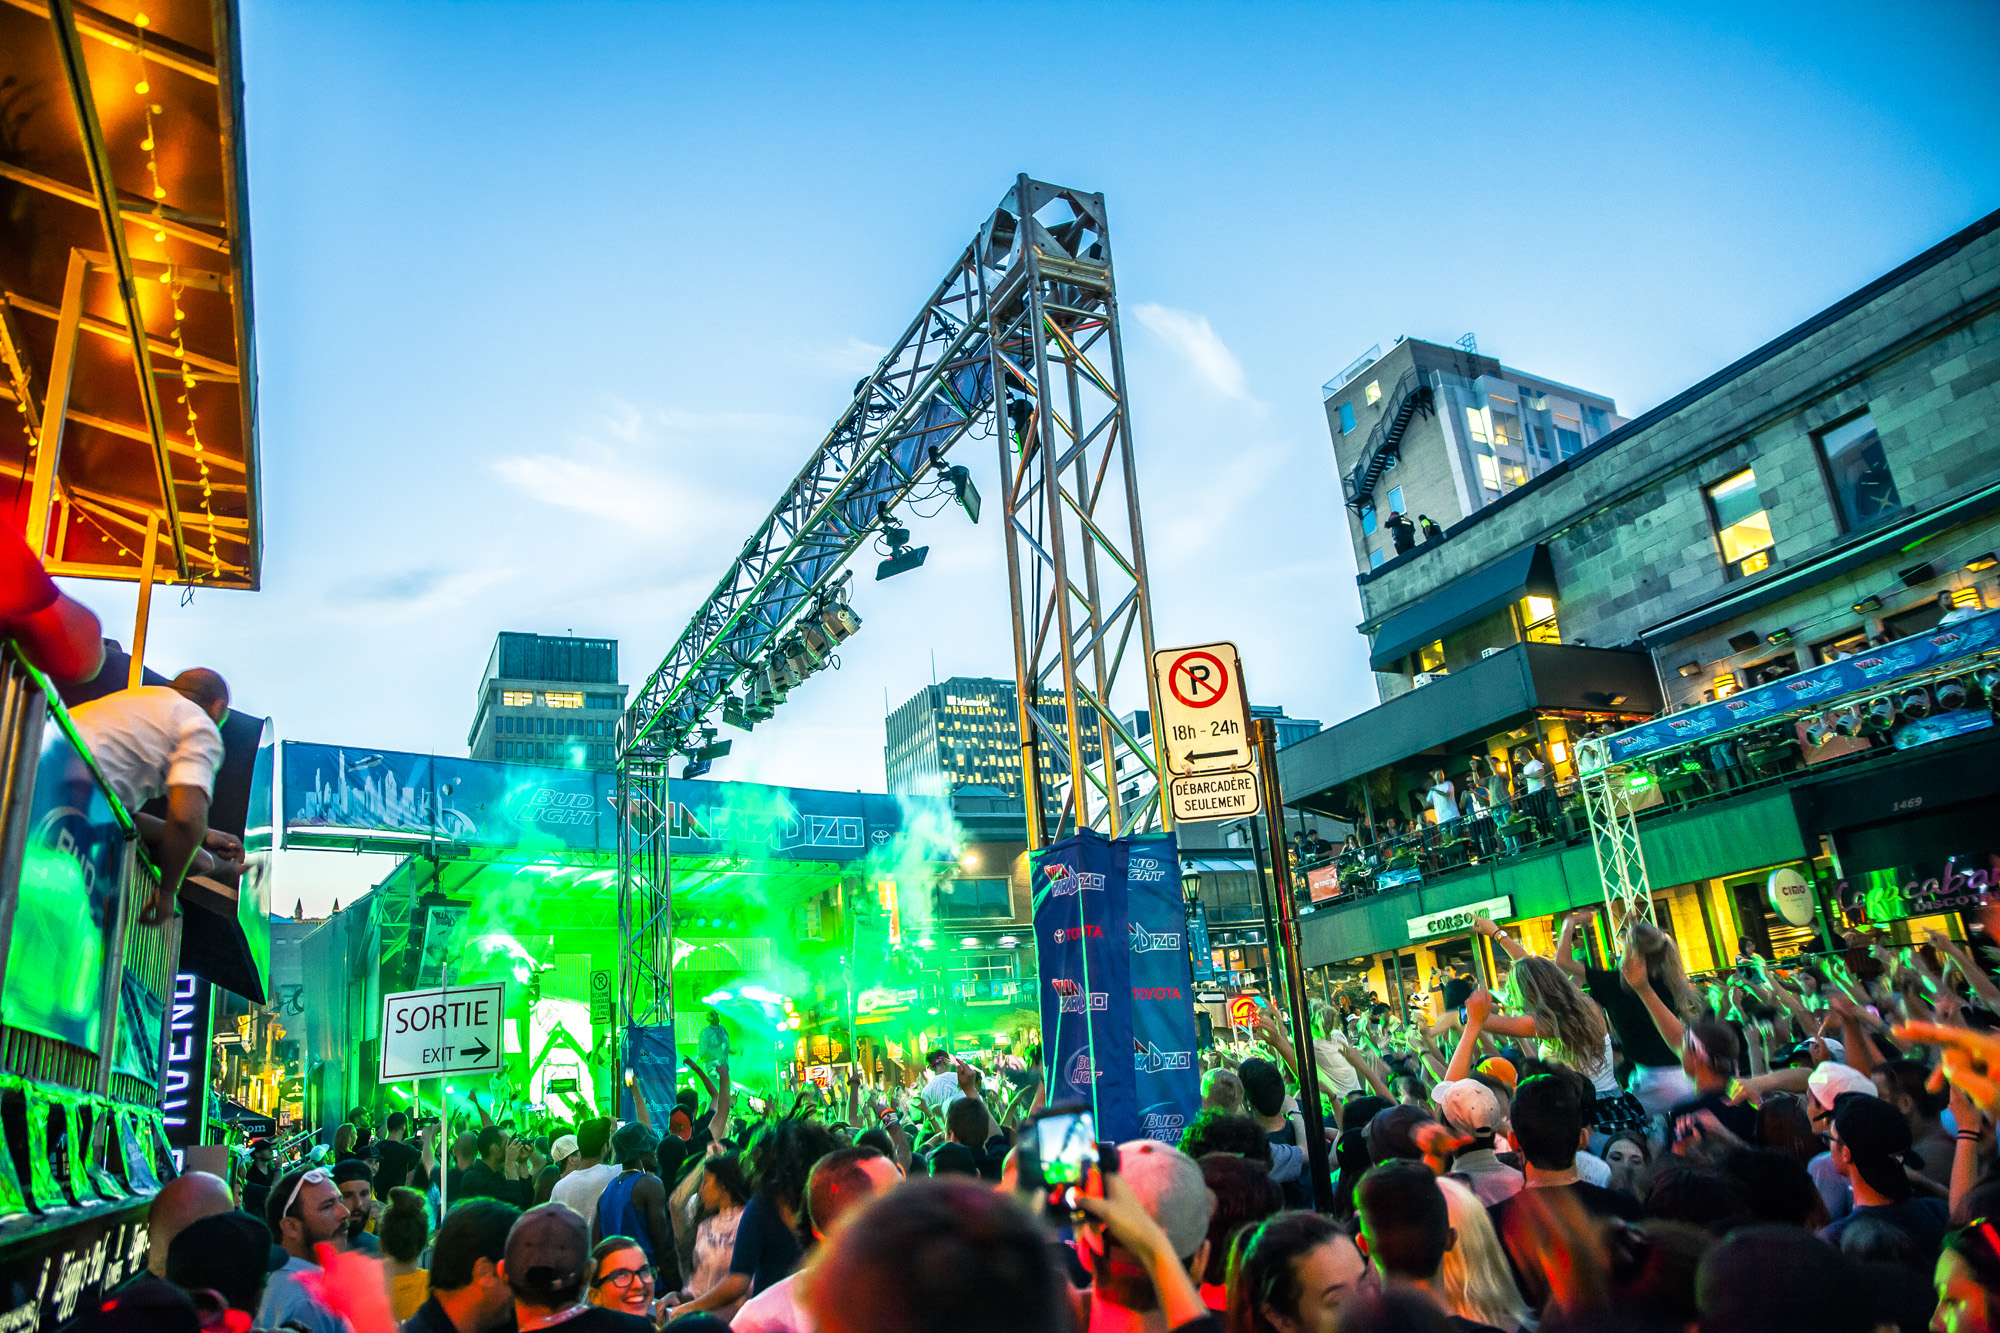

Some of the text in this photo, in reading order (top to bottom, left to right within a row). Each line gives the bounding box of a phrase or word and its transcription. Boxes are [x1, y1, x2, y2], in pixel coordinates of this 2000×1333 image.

[1172, 725, 1197, 741] 18h
[1210, 719, 1239, 737] 24h
[1175, 777, 1252, 796] DÉBARCADÈRE
[530, 788, 594, 809] BUD
[1184, 795, 1247, 812] SEULEMENT
[1893, 797, 1922, 811] 1469
[515, 804, 602, 825] LIGHT
[1427, 912, 1473, 933] CORSO
[1131, 987, 1182, 1000] TOYOTA
[395, 1000, 489, 1034] SORTIE
[422, 1046, 455, 1064] EXIT
[1144, 1113, 1185, 1129] BUD
